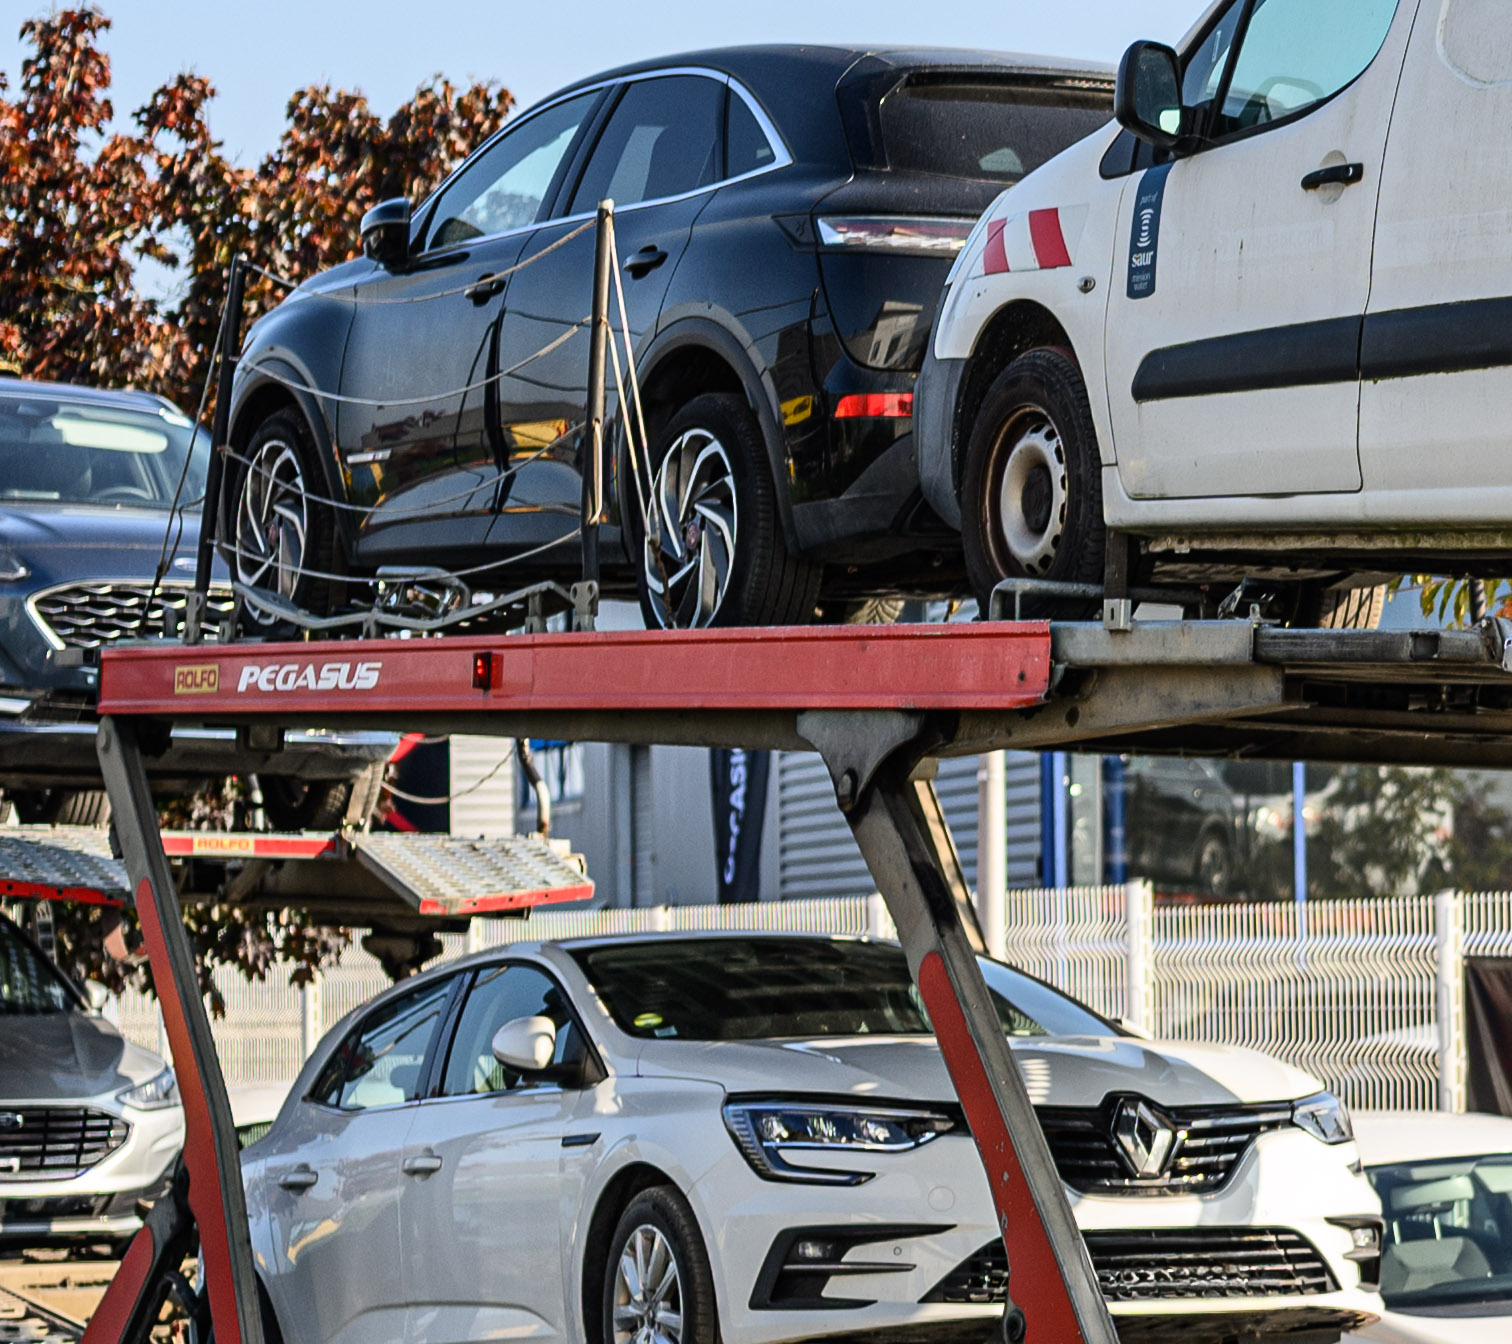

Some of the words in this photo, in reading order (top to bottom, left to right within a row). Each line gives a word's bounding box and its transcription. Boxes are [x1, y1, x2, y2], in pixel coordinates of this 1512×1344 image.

[1131, 251, 1154, 268] saur
[176, 668, 217, 690] ROLFO
[237, 662, 382, 693] PEGASUS
[197, 838, 250, 851] ROLFO
